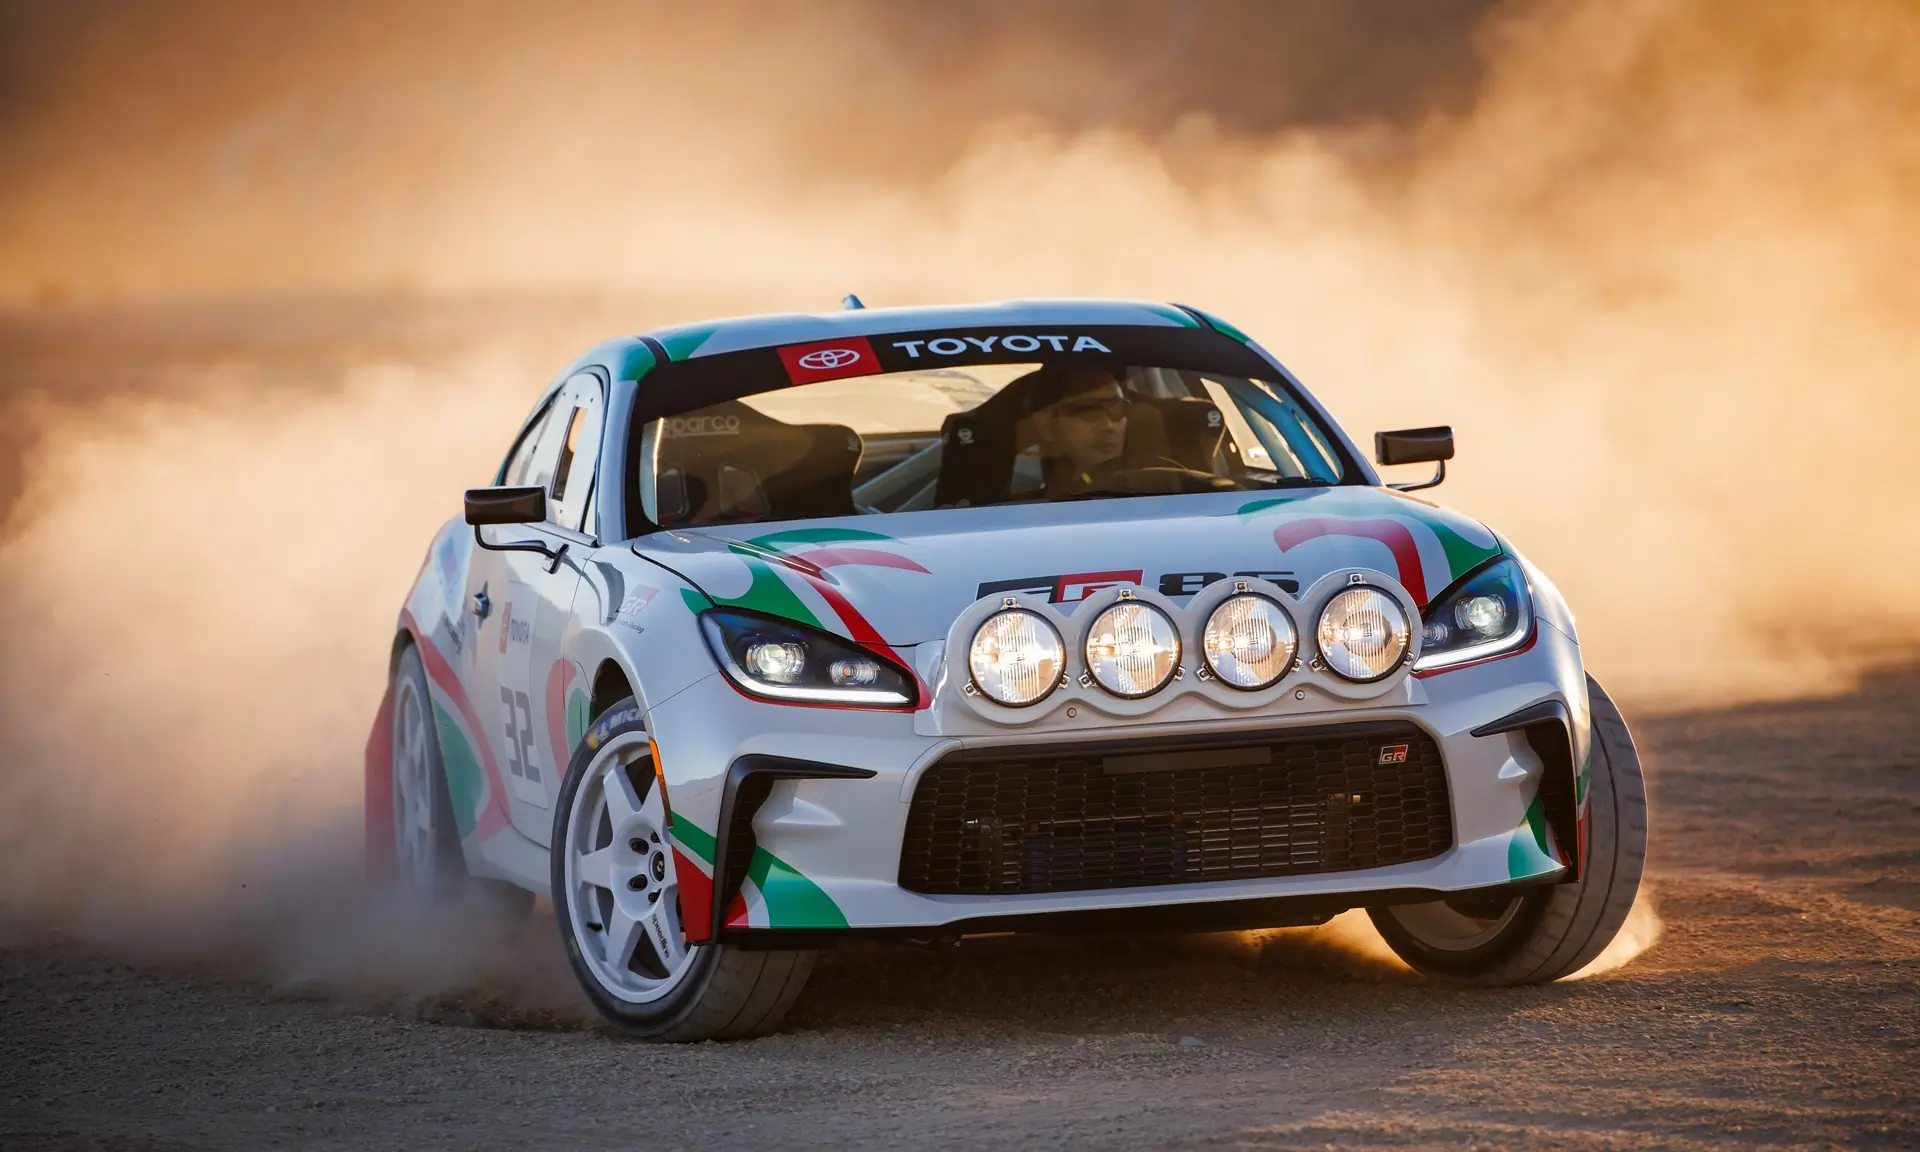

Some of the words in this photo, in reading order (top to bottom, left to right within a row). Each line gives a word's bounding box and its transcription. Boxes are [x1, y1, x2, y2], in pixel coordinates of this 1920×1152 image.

[892, 335, 1112, 358] TOYOTA
[500, 685, 541, 784] 32
[1380, 749, 1407, 763] GR
